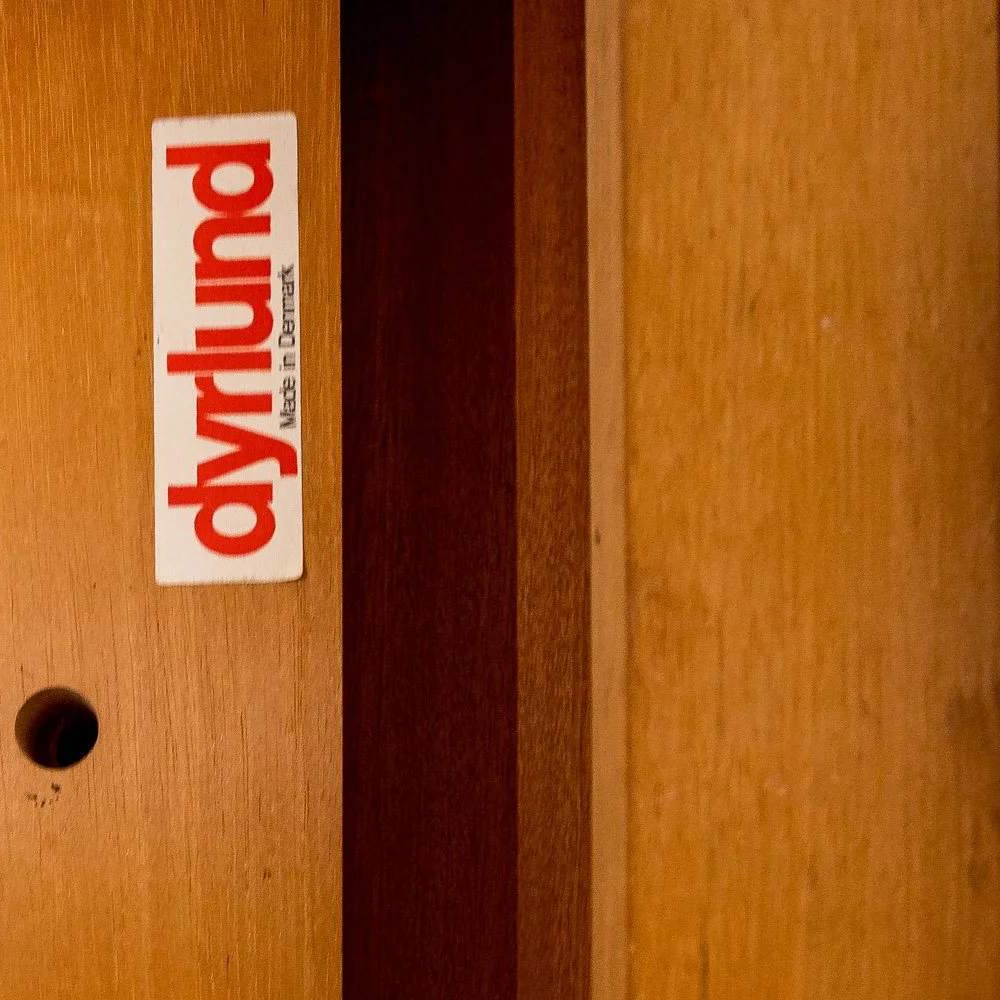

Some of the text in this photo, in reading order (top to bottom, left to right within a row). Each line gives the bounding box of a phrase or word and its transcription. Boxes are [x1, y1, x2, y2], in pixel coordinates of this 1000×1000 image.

[166, 140, 298, 557] dyrlund
[277, 263, 296, 428] Made in Denmark
